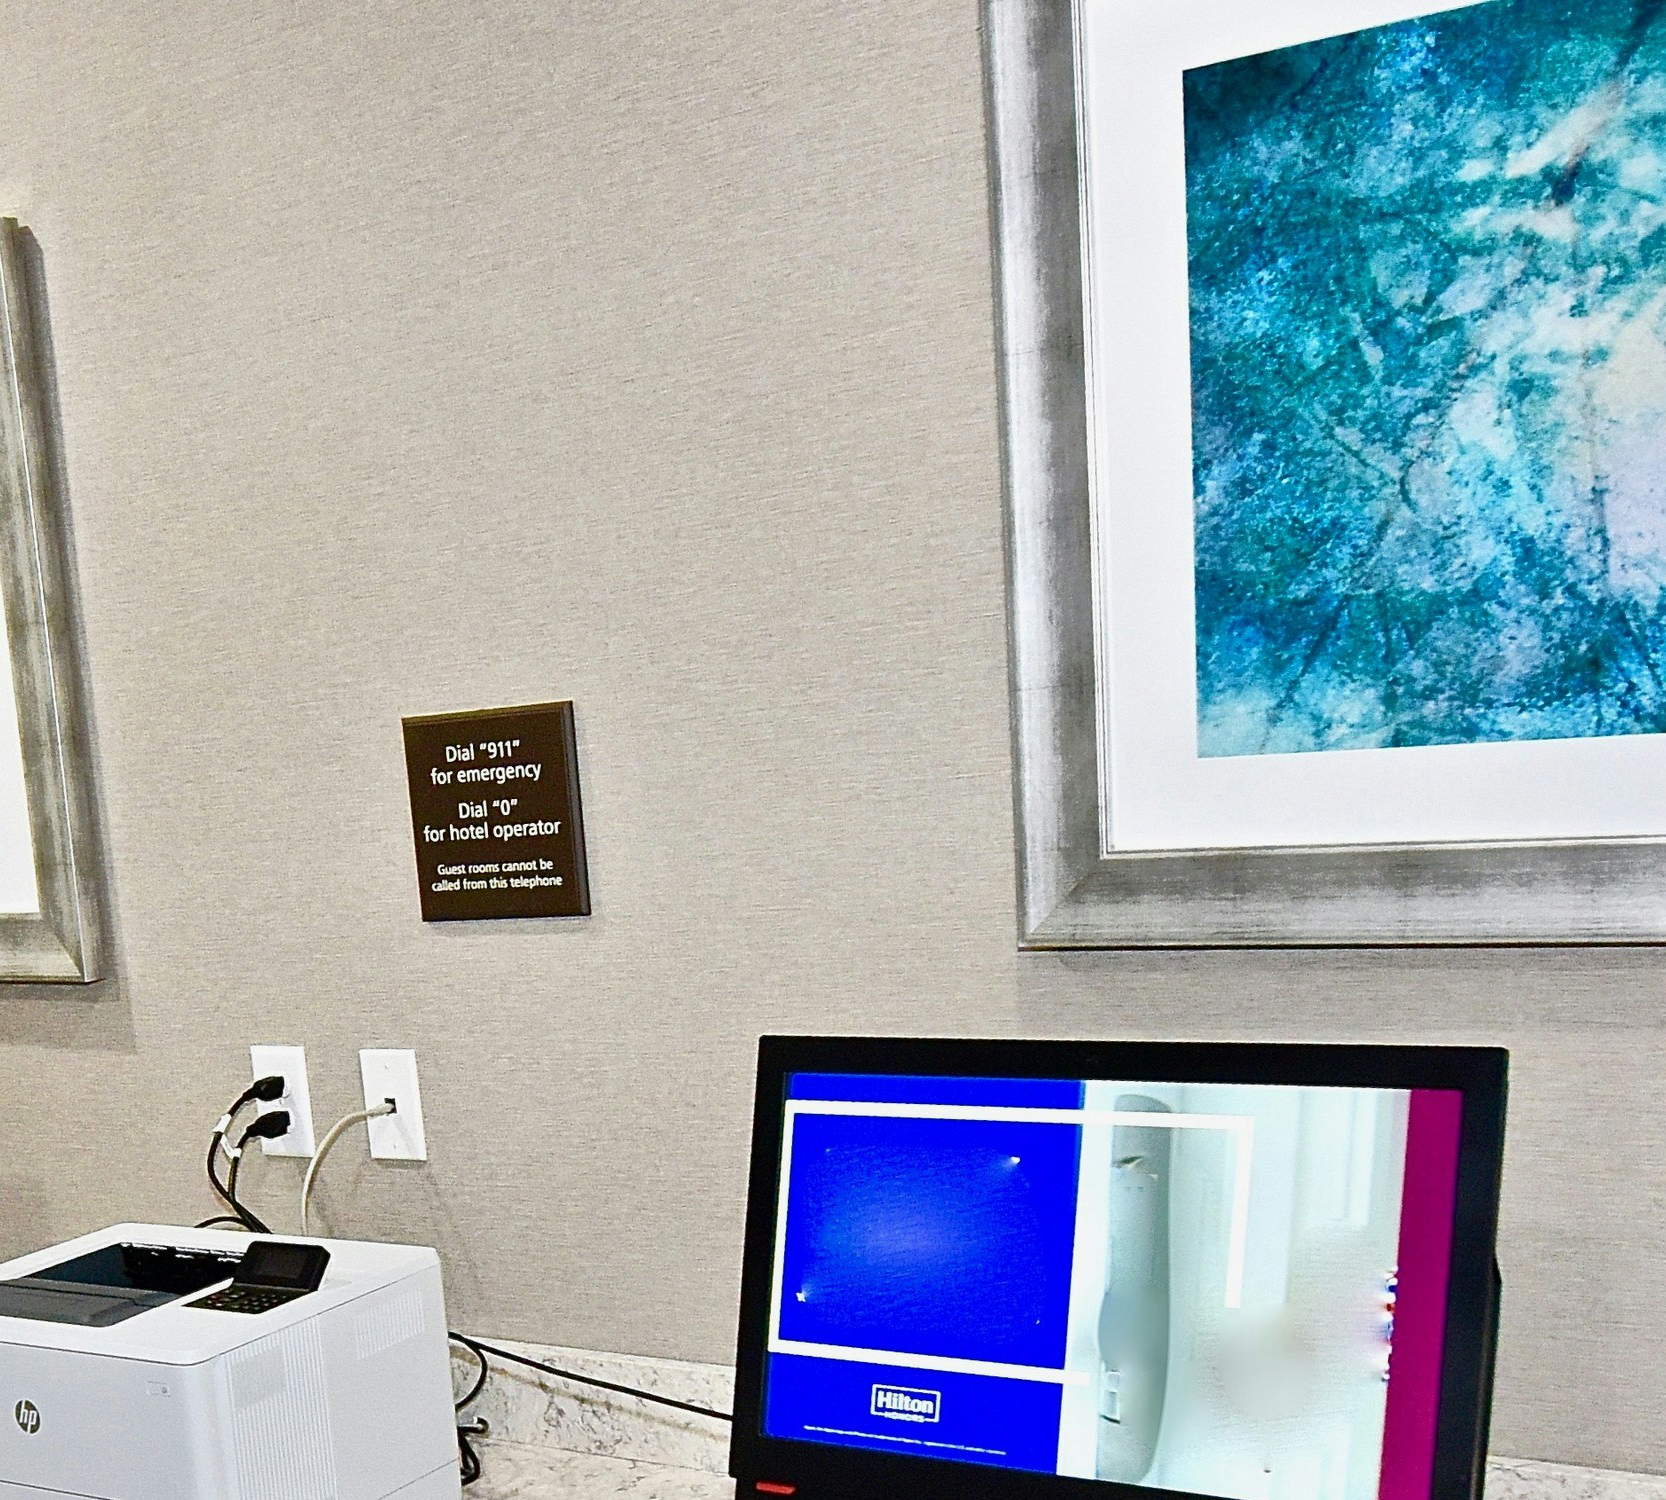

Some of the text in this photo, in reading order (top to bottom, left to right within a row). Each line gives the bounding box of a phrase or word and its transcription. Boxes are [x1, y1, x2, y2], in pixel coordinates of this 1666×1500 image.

[446, 743, 474, 762] Dial
[430, 764, 541, 785] for emergency
[458, 801, 487, 819] Dial
[423, 820, 561, 842] for hotel operator
[437, 859, 553, 876] Guest rooms cannot be
[431, 875, 563, 892] called from this telephone
[877, 1390, 934, 1414] Hilton
[19, 1399, 37, 1434] hp
